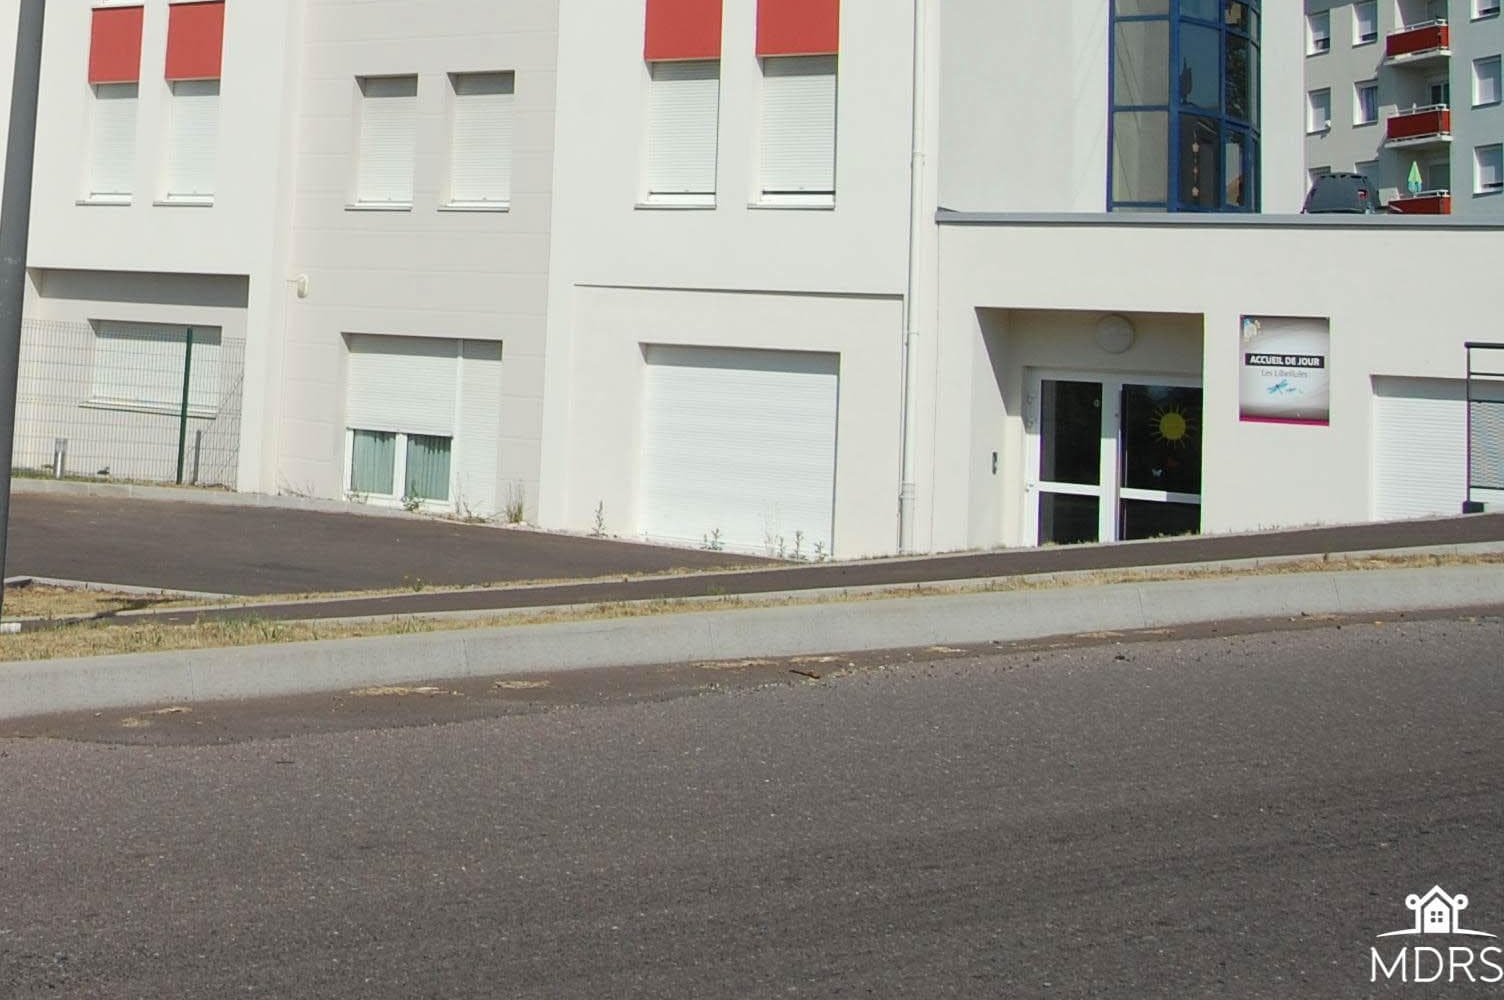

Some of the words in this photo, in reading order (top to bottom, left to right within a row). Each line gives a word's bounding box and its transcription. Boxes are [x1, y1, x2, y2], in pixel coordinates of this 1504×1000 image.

[1250, 356, 1283, 365] ACCUEIL
[1285, 357, 1296, 365] DE
[1297, 358, 1320, 366] JOUR
